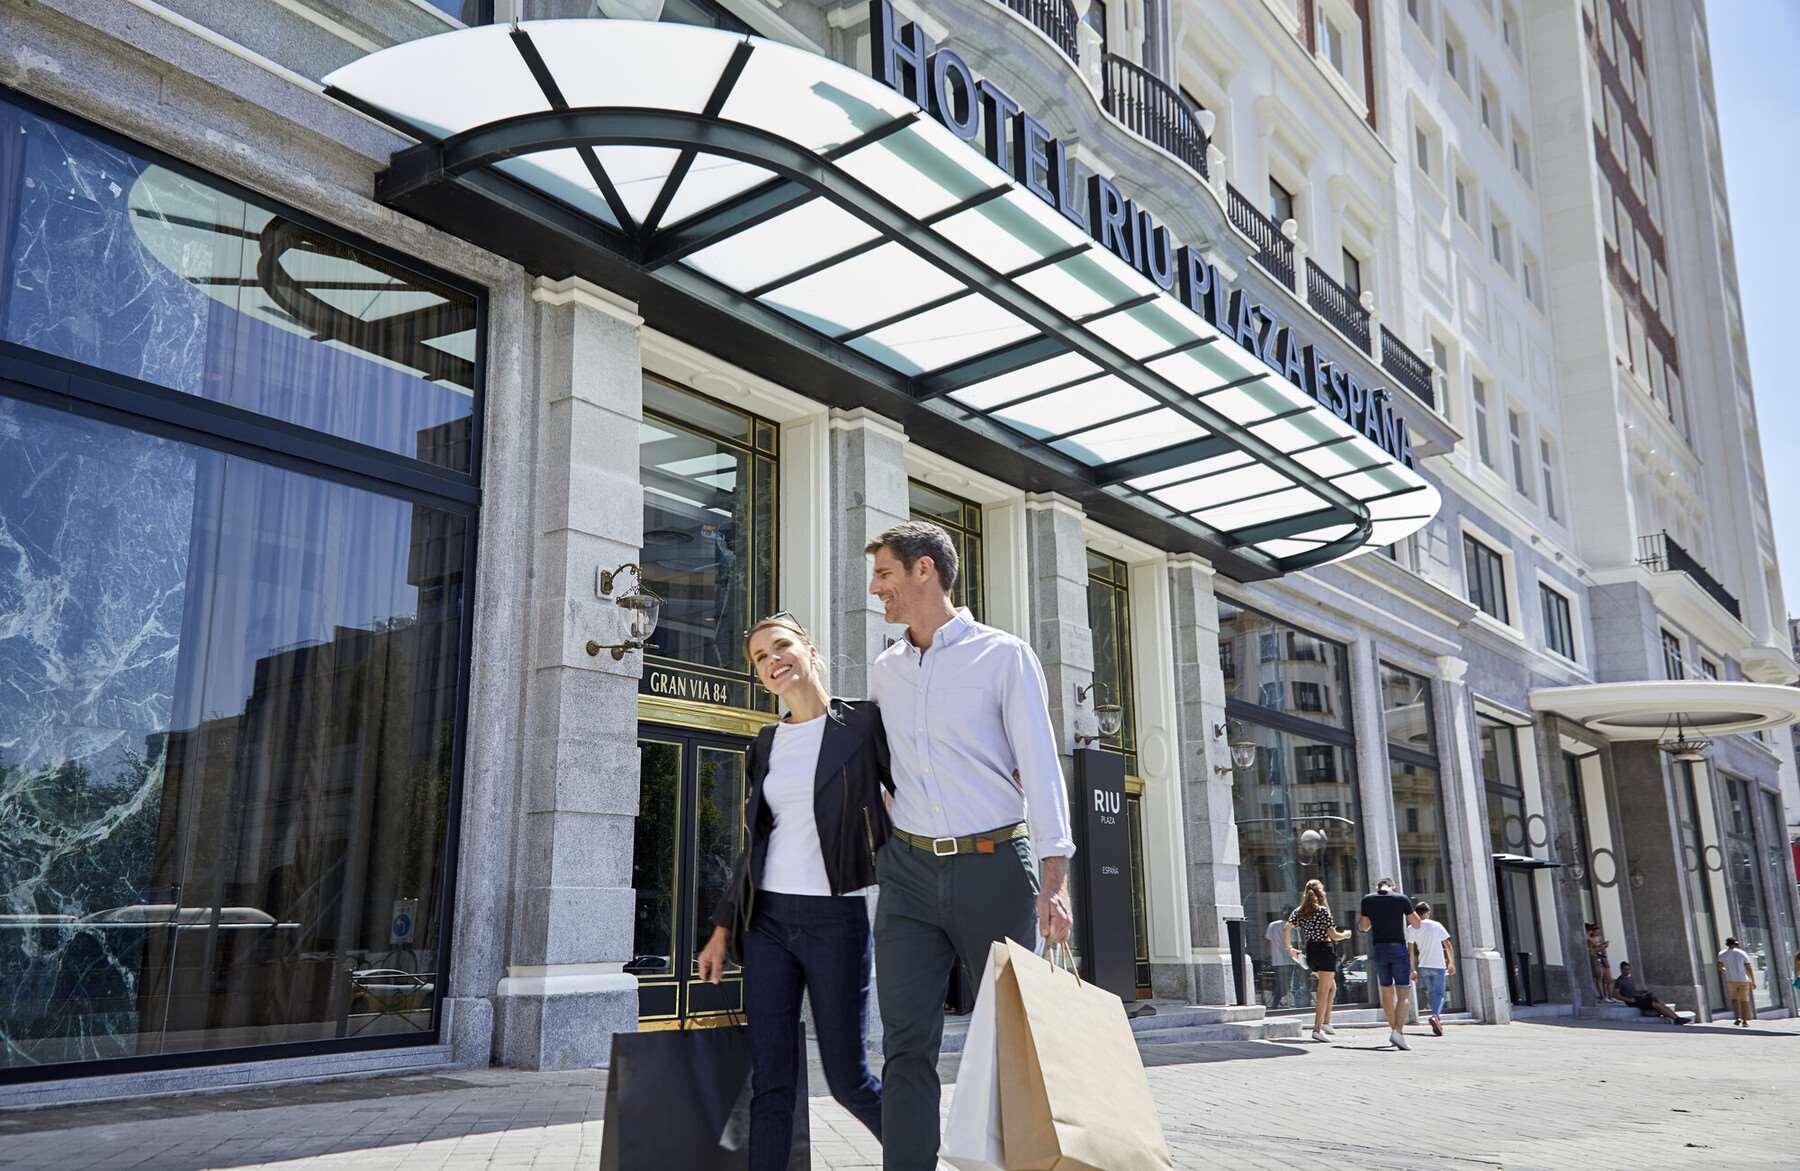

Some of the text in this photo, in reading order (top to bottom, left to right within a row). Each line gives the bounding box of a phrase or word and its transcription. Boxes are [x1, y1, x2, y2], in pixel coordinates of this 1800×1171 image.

[870, 0, 1417, 471] HOTEL RIU PLAZA ESPAÑA
[650, 672, 727, 703] GRAN VIA 84
[1094, 788, 1121, 814] RIU
[1100, 815, 1116, 825] PLAZA
